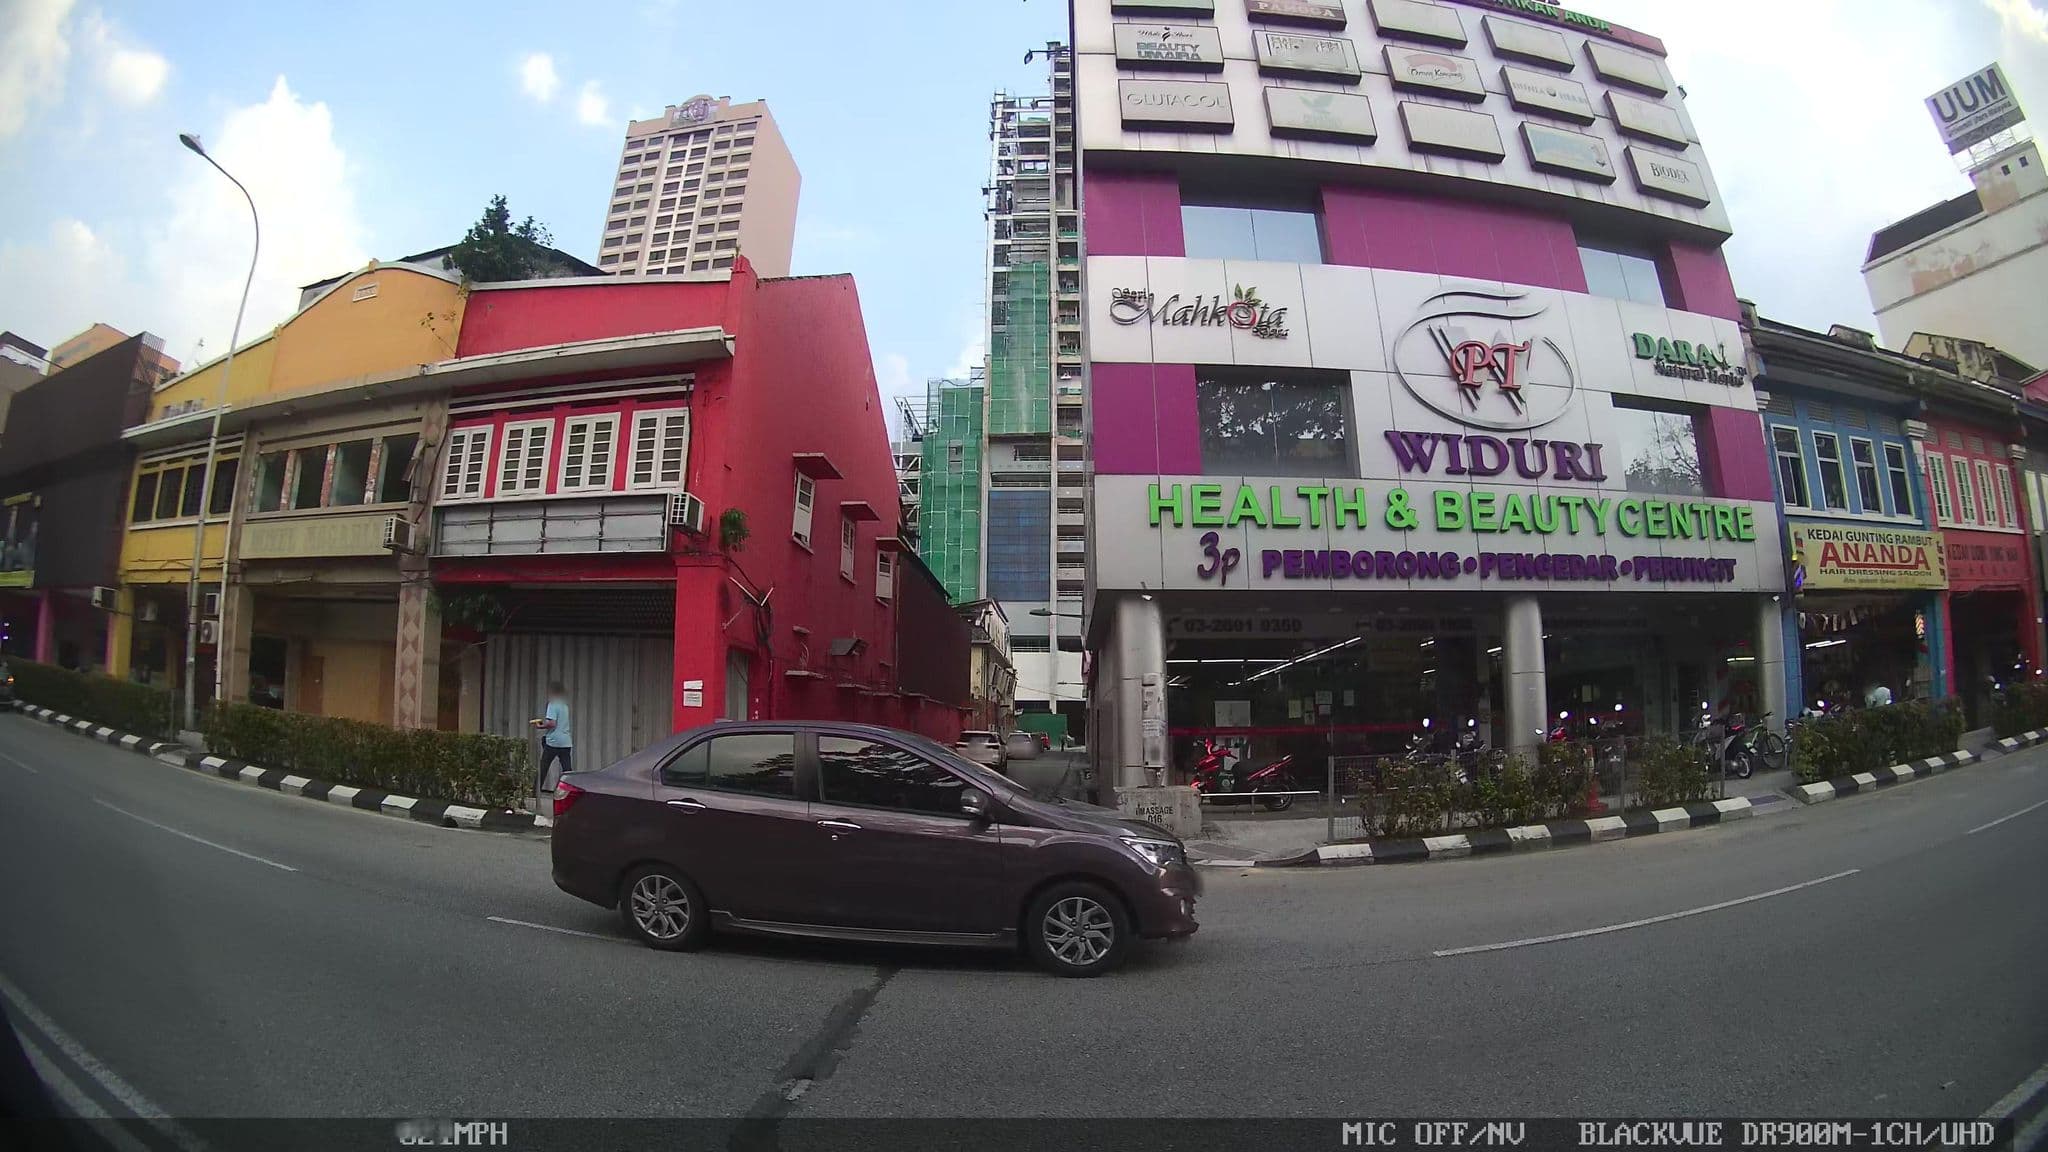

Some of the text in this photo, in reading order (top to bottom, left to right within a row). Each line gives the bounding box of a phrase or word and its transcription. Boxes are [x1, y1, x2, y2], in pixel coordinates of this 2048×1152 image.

[1564, 10, 1611, 32] ANDA
[1136, 42, 1200, 52] BEAUTY
[1932, 68, 2006, 123] UUM
[1110, 293, 1288, 328] Mahkota
[1451, 341, 1530, 389] PT
[1384, 431, 1607, 481] WIDURI
[1148, 484, 1757, 541] HEALTH & BEAUTY CENTRE
[1807, 528, 1934, 547] KEDAI GUNTING RAMBUT
[1262, 549, 1461, 580] PEMBORONG
[1480, 551, 1619, 581] PENGEDAR
[1632, 555, 1738, 583] PERUNCIT
[1819, 568, 1932, 577] HAIR DRESSING SALOON
[1820, 541, 1931, 570] ANANDA
